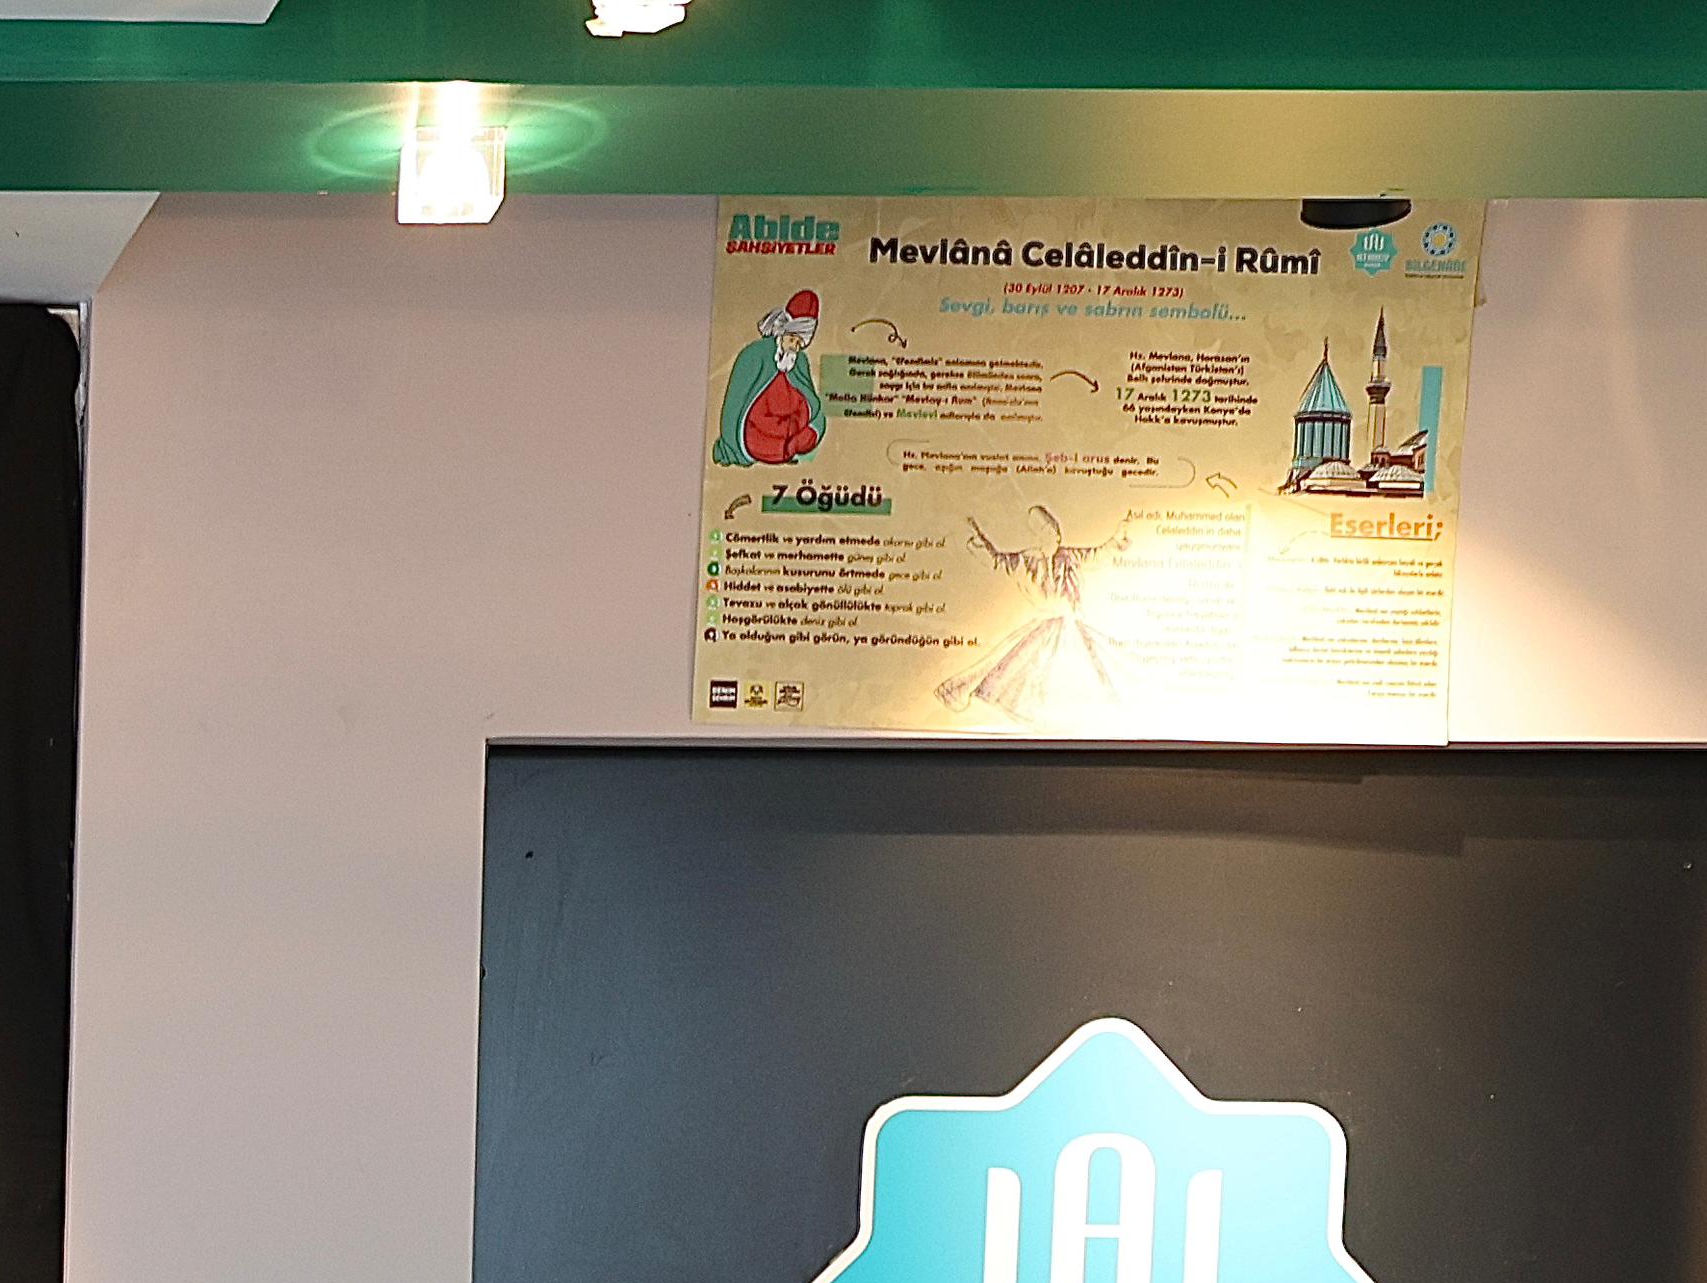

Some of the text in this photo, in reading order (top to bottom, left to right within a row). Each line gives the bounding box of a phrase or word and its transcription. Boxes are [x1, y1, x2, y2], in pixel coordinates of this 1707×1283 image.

[869, 237, 1322, 275] Mevlânâ Celâleddîn-i Rûmî
[1152, 287, 1184, 298] 1273)
[1116, 386, 1135, 400] 17
[1172, 388, 1212, 403] 1273
[771, 479, 883, 512] 7 Öğüdü
[1329, 512, 1444, 541] Eserleri;
[725, 532, 779, 544] Cömertlik
[723, 580, 762, 592] Hiddet
